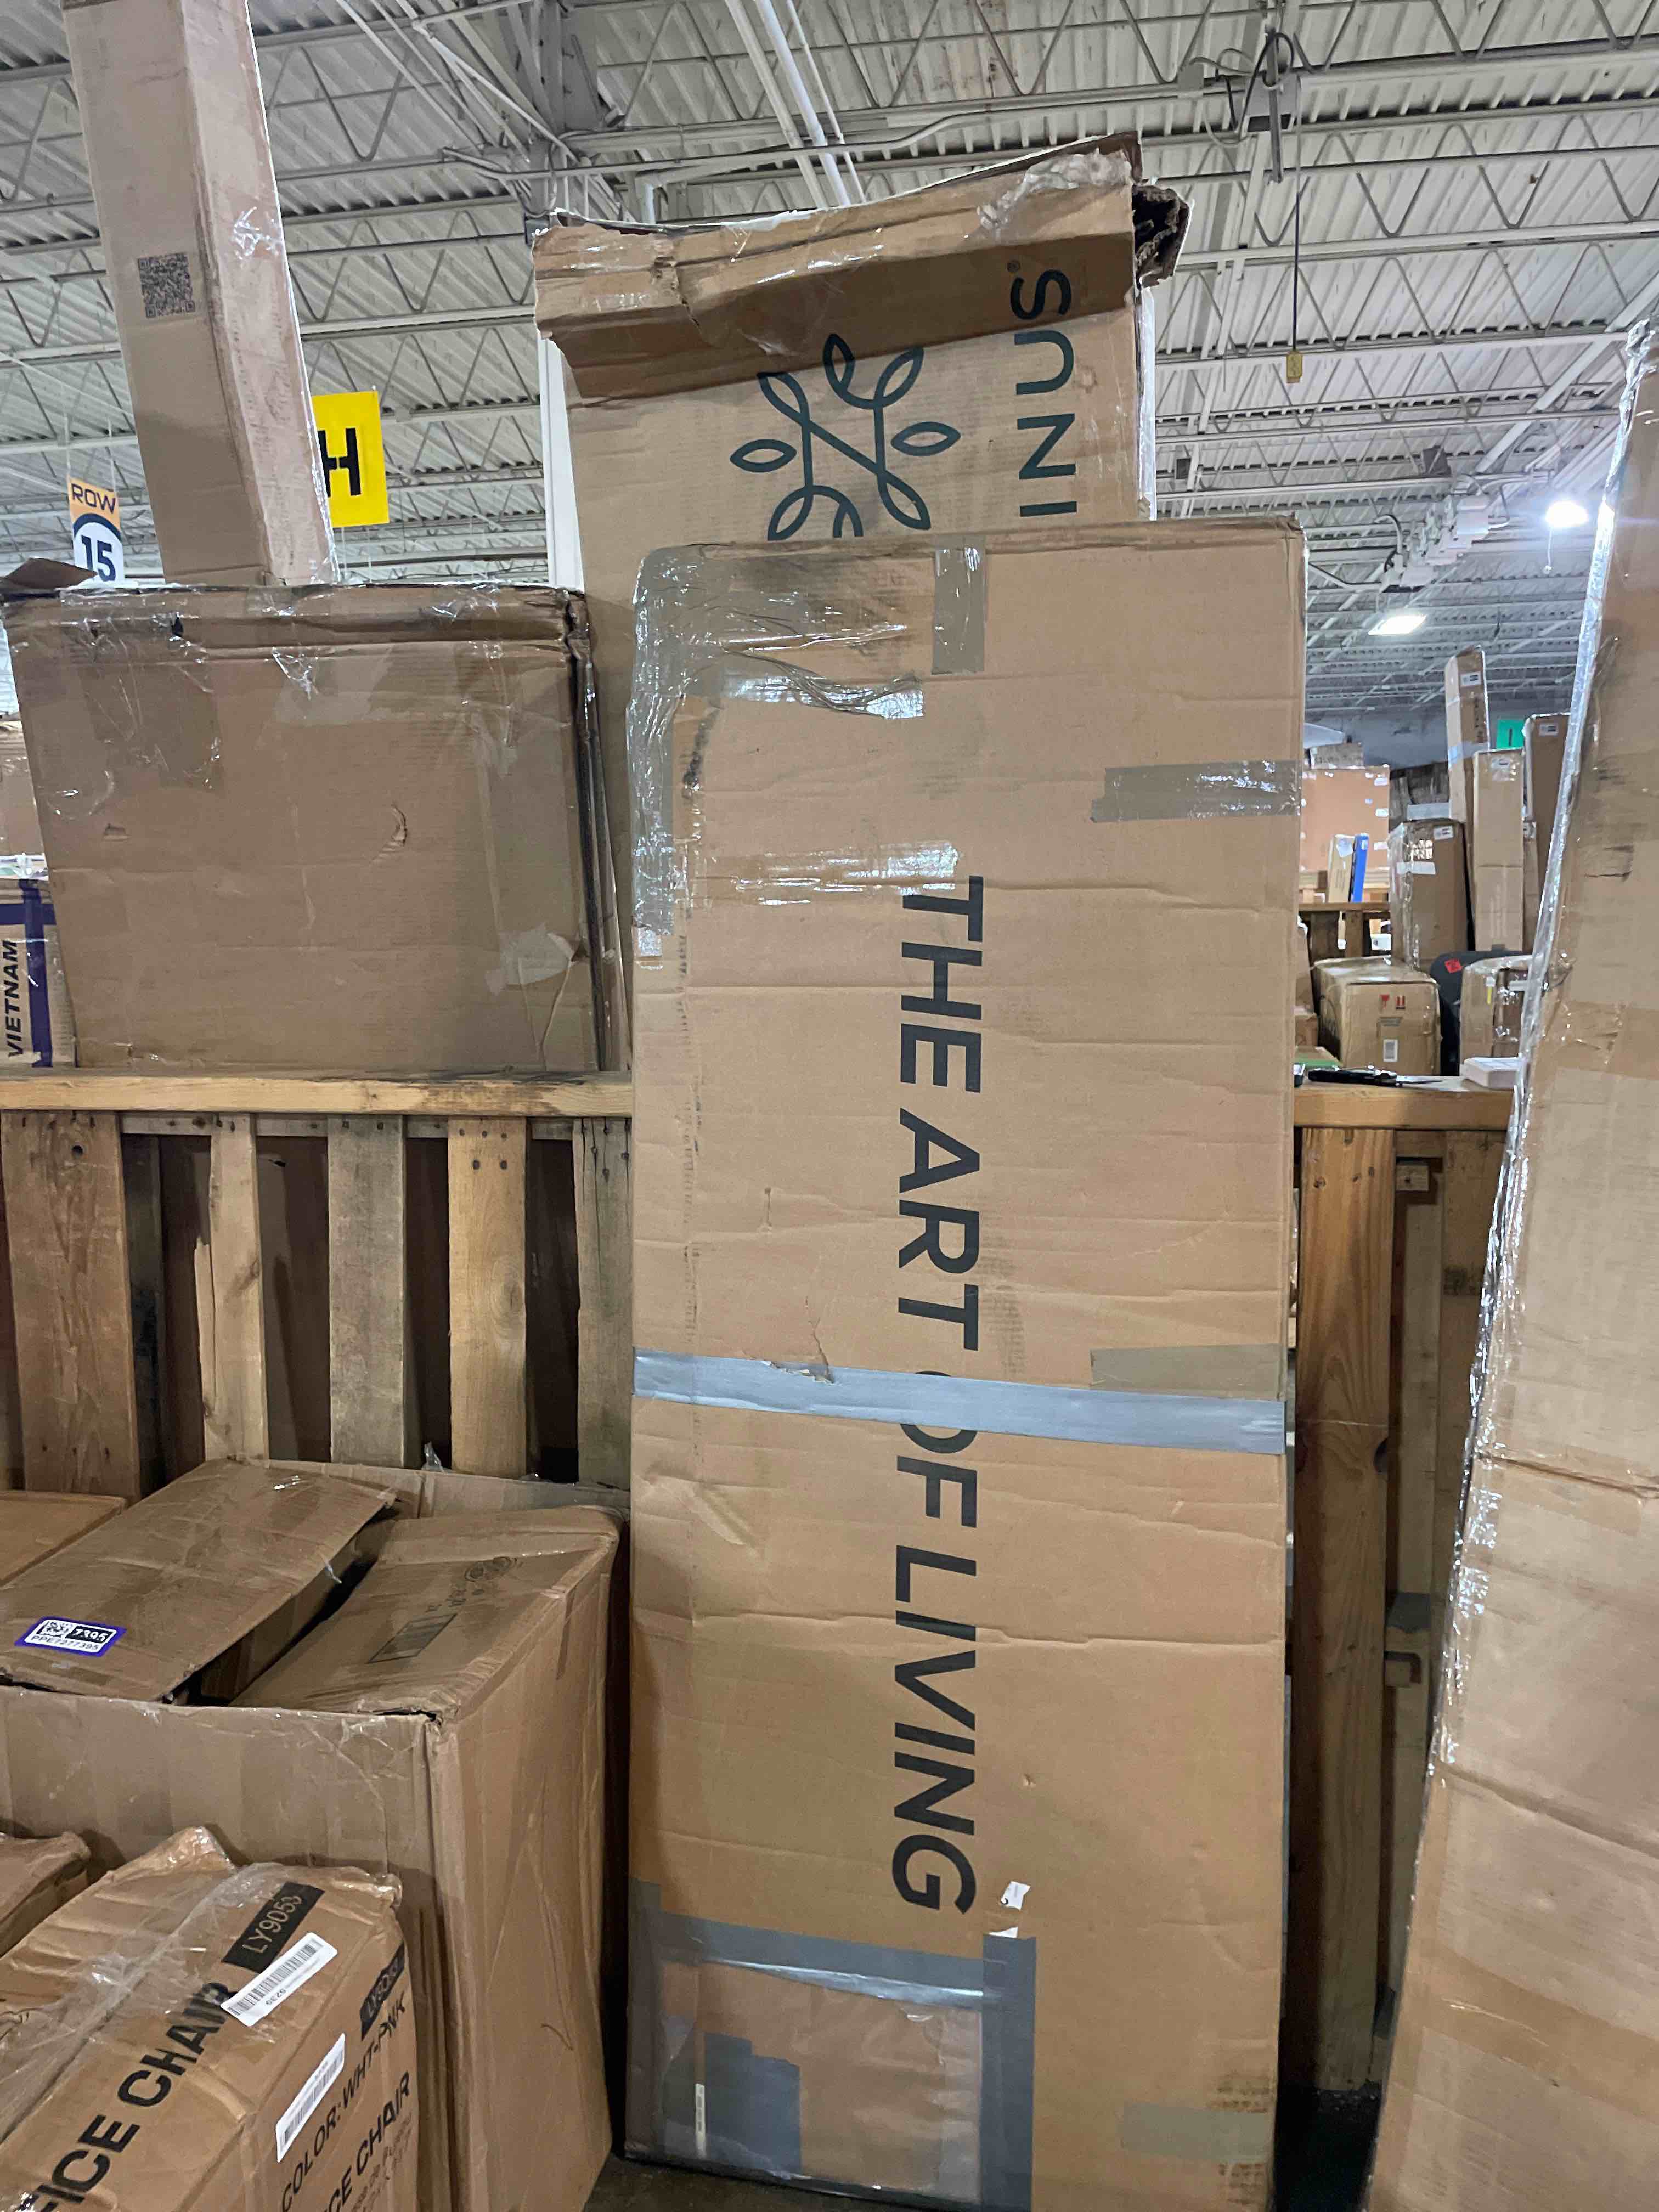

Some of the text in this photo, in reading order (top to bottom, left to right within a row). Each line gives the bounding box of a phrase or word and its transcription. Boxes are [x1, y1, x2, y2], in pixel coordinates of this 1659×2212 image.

[71, 483, 116, 514] ROW
[317, 427, 362, 498] H
[81, 535, 116, 582] 15
[2, 940, 24, 1057] VIETNAM
[900, 876, 983, 1093] THE
[898, 1107, 980, 1351] ART
[72, 1628, 109, 1642] 7395
[892, 1544, 977, 1915] LIVING
[242, 1895, 302, 1954] LY9053
[117, 1983, 238, 2107] CHAIR
[325, 2166, 352, 2212] CE
[357, 2071, 410, 2176] CHAIR
